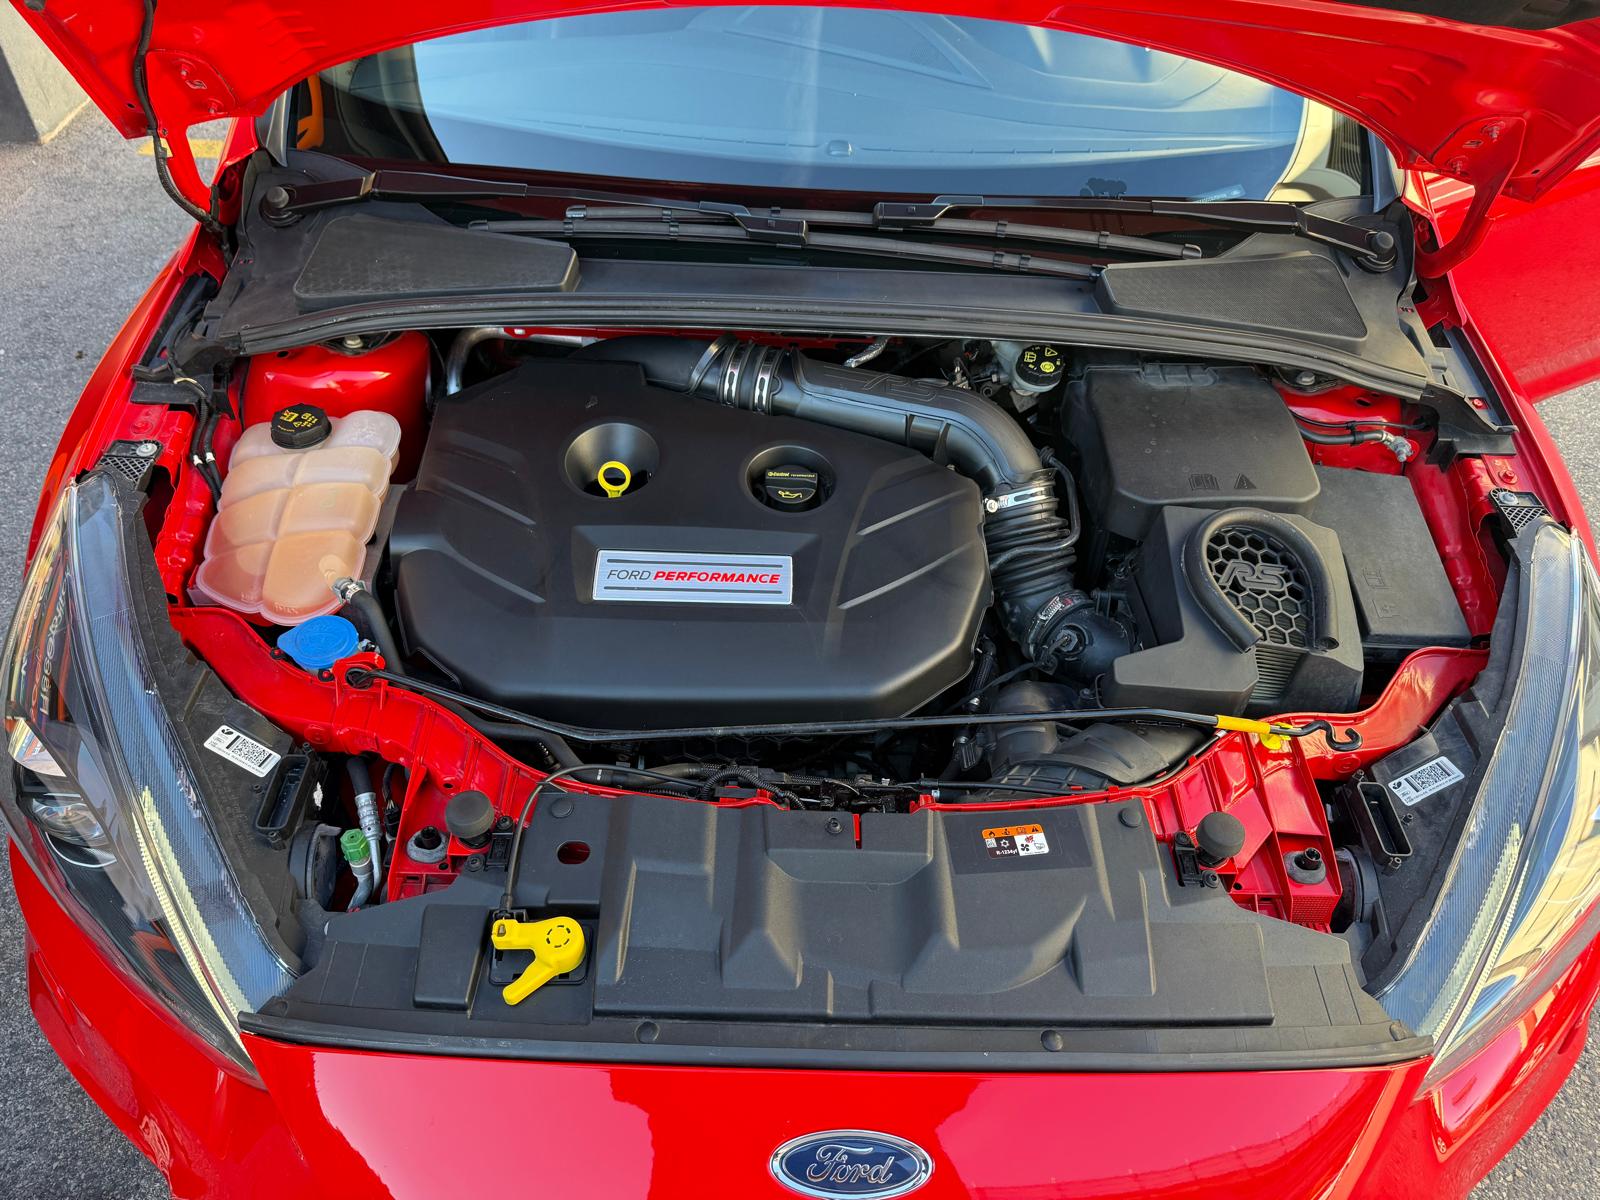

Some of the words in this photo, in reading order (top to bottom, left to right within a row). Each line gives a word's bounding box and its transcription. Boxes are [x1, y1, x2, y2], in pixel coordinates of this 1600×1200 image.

[606, 569, 651, 581] FORD
[653, 570, 781, 584] PERFORMANCE
[1218, 559, 1288, 591] RS
[806, 1144, 894, 1184] Ford
